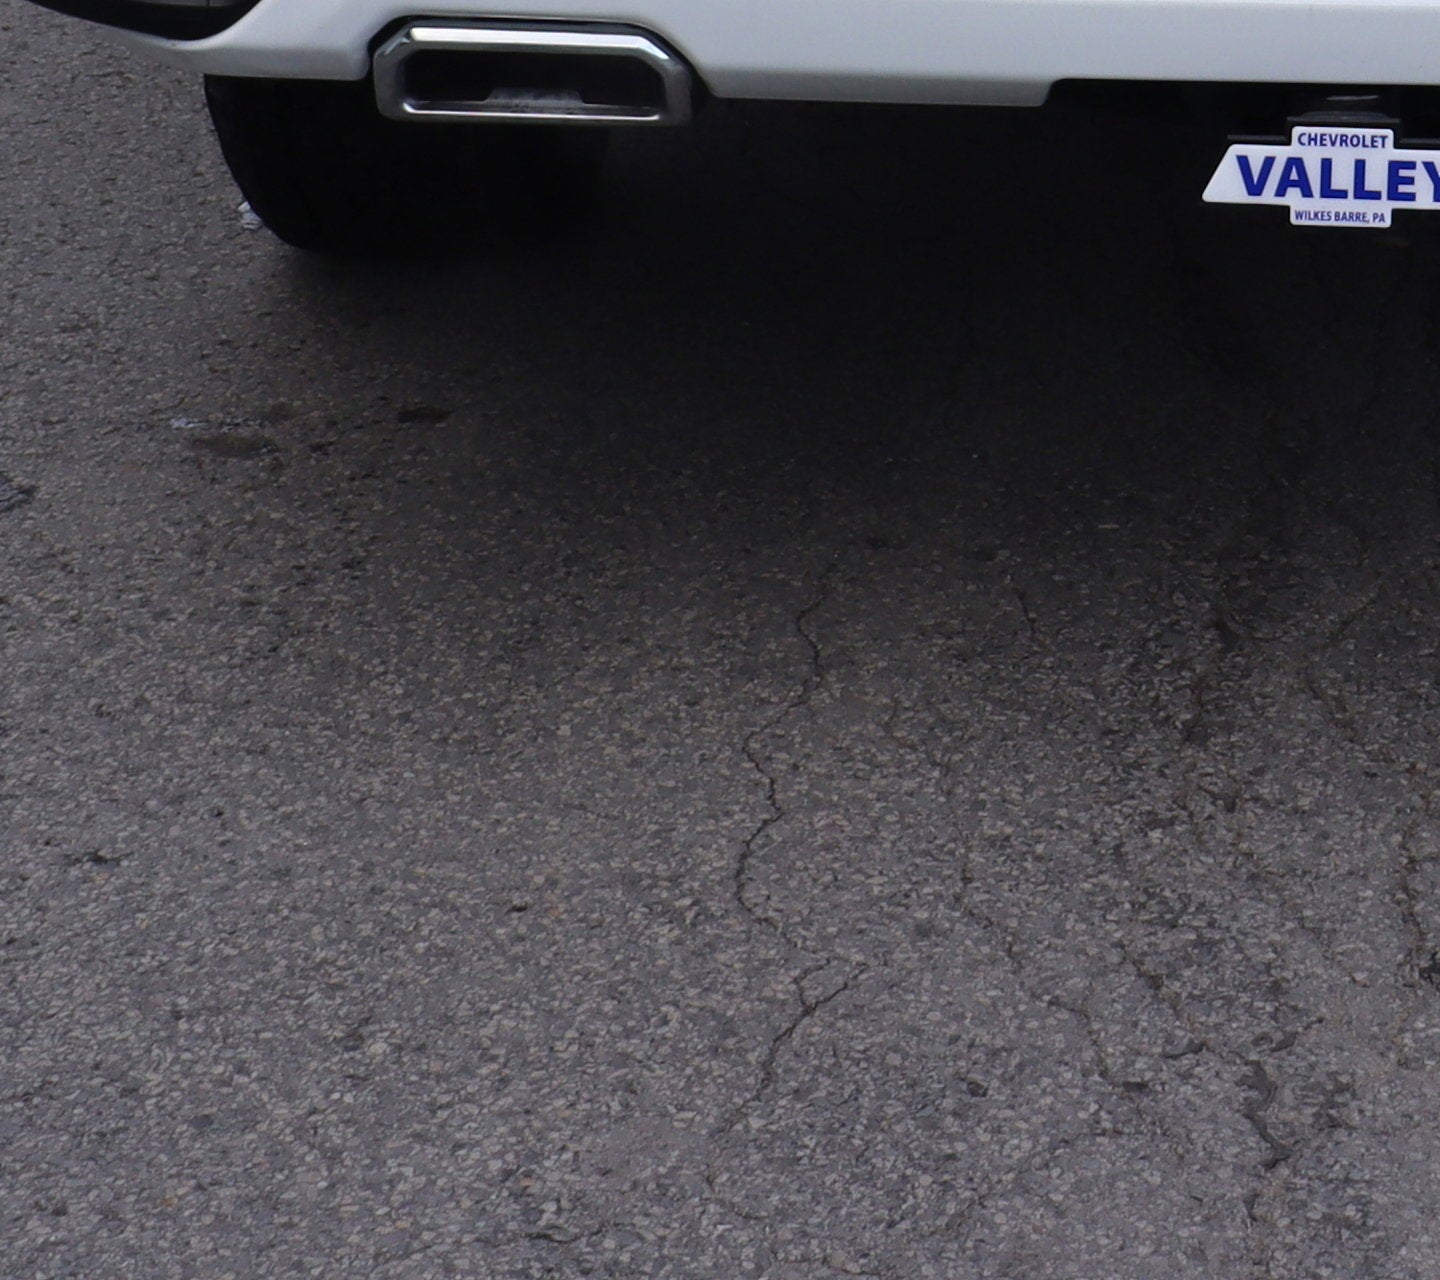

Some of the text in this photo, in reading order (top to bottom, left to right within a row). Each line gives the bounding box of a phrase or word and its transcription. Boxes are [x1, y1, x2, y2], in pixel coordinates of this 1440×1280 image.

[1297, 132, 1389, 149] CHEVROLET
[1295, 210, 1386, 224] WILKES BARRE, PA
